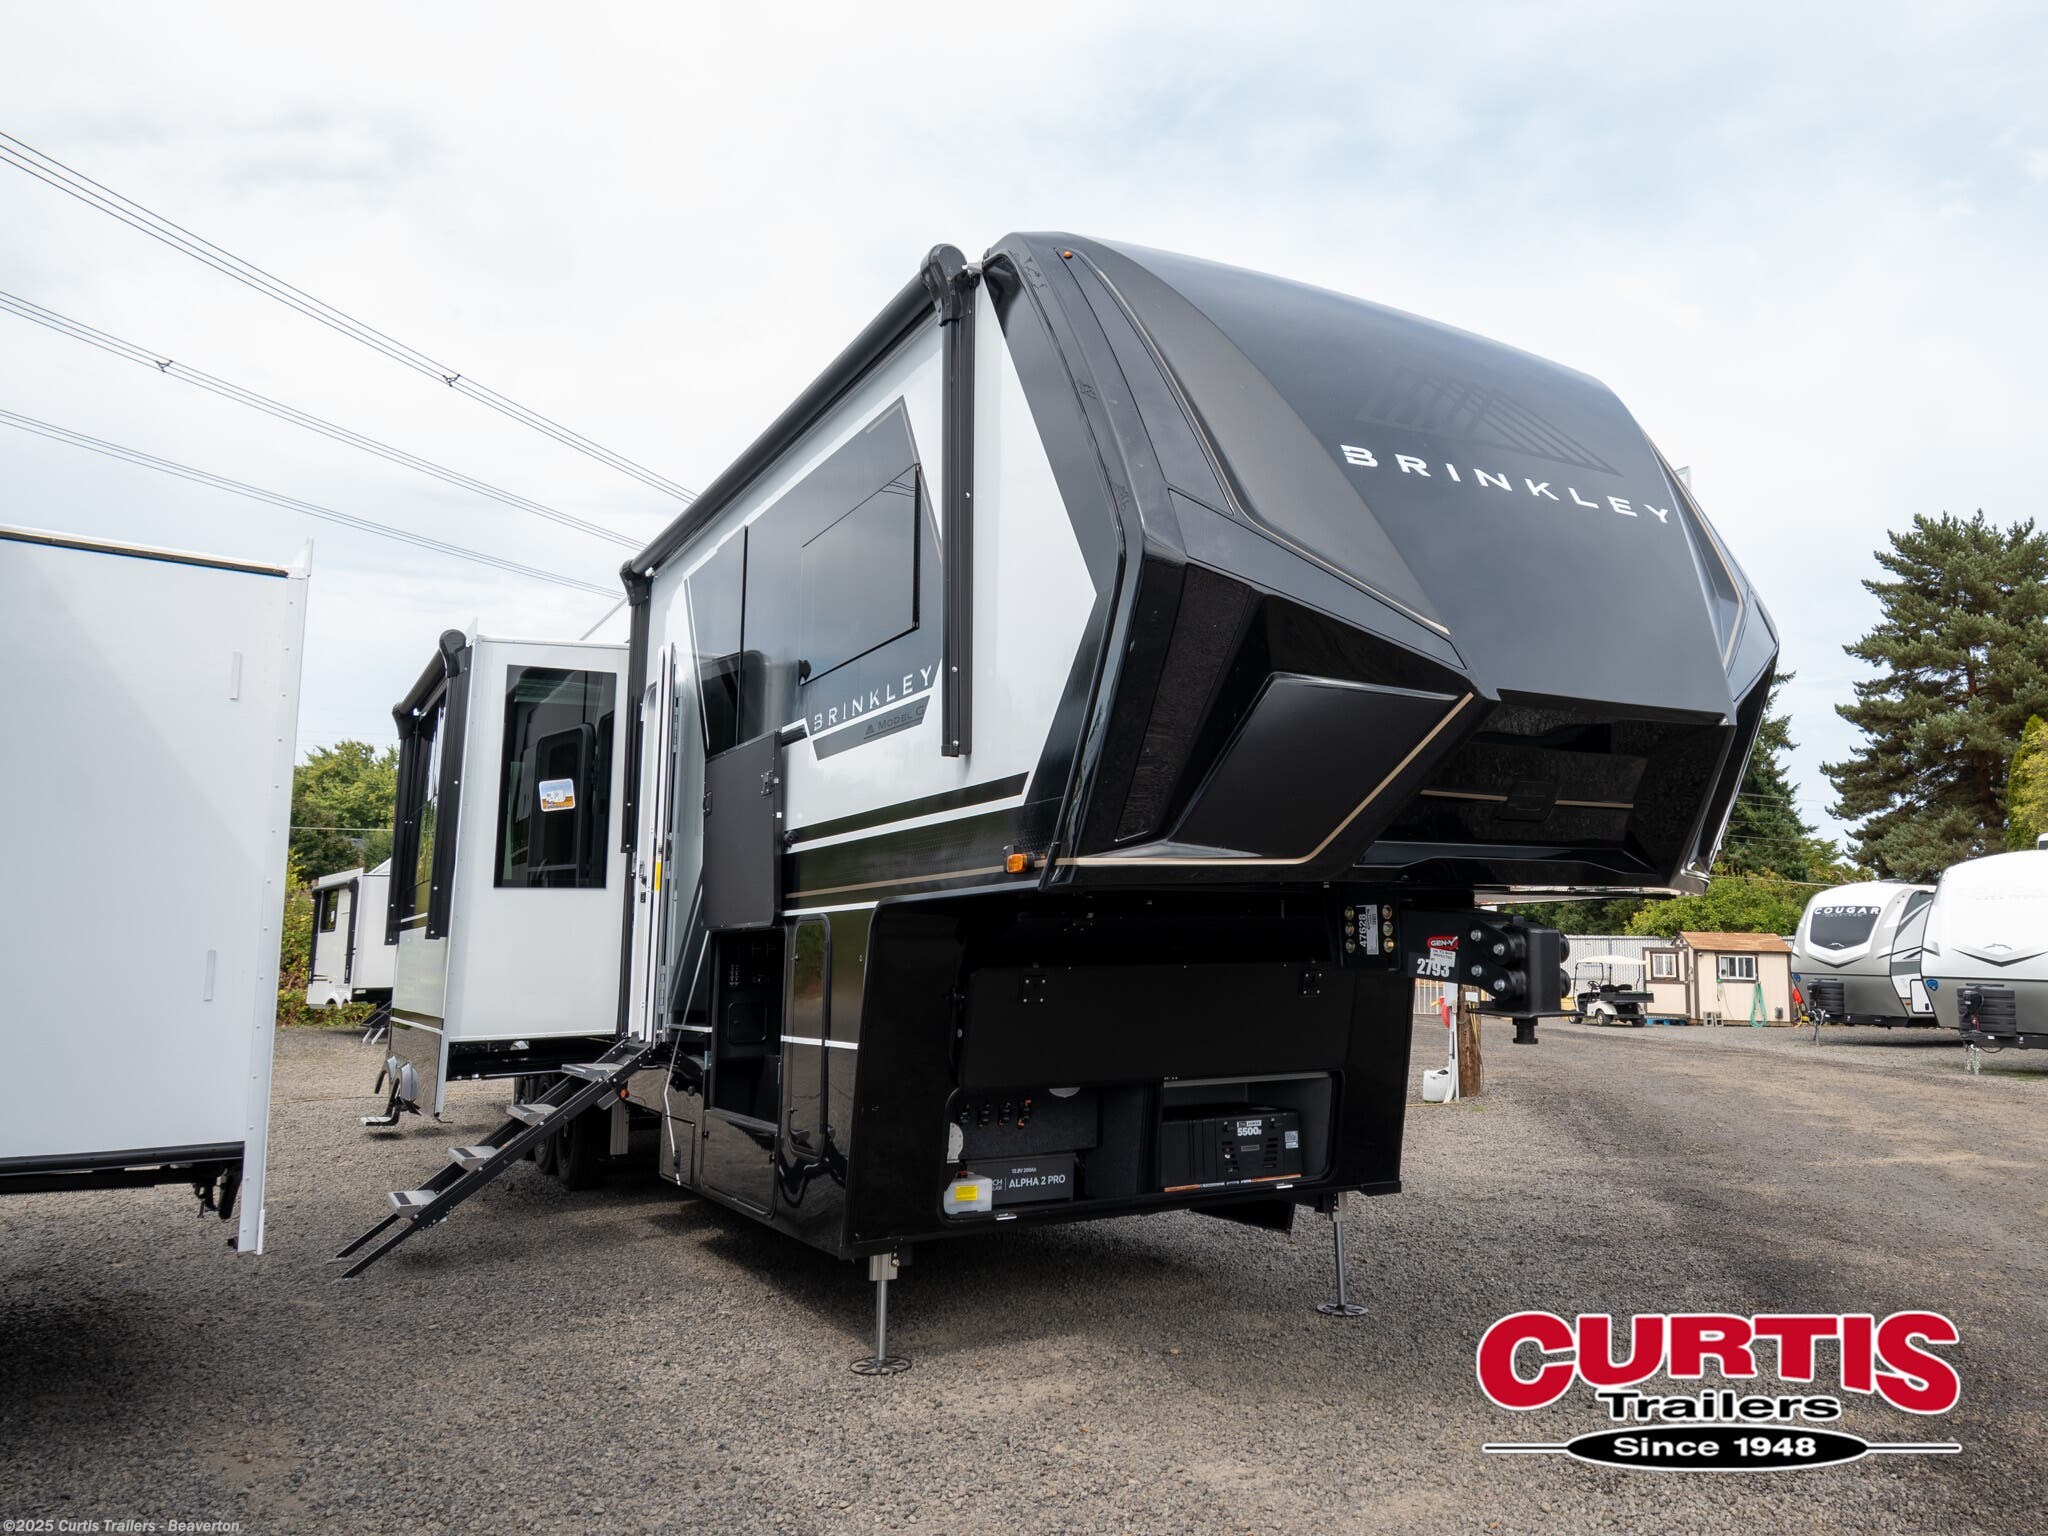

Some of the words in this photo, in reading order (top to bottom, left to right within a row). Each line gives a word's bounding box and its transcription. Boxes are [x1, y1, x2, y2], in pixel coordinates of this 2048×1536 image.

[1340, 444, 1669, 523] BRINKLEY
[813, 665, 932, 732] BRINKLEY
[1814, 906, 1880, 915] COUGAR
[1358, 913, 1368, 948] 47628
[1416, 958, 1450, 978] 2793
[1008, 1177, 1039, 1188] ALPHA
[1040, 1176, 1047, 1185] 2
[1047, 1174, 1066, 1184] PRO
